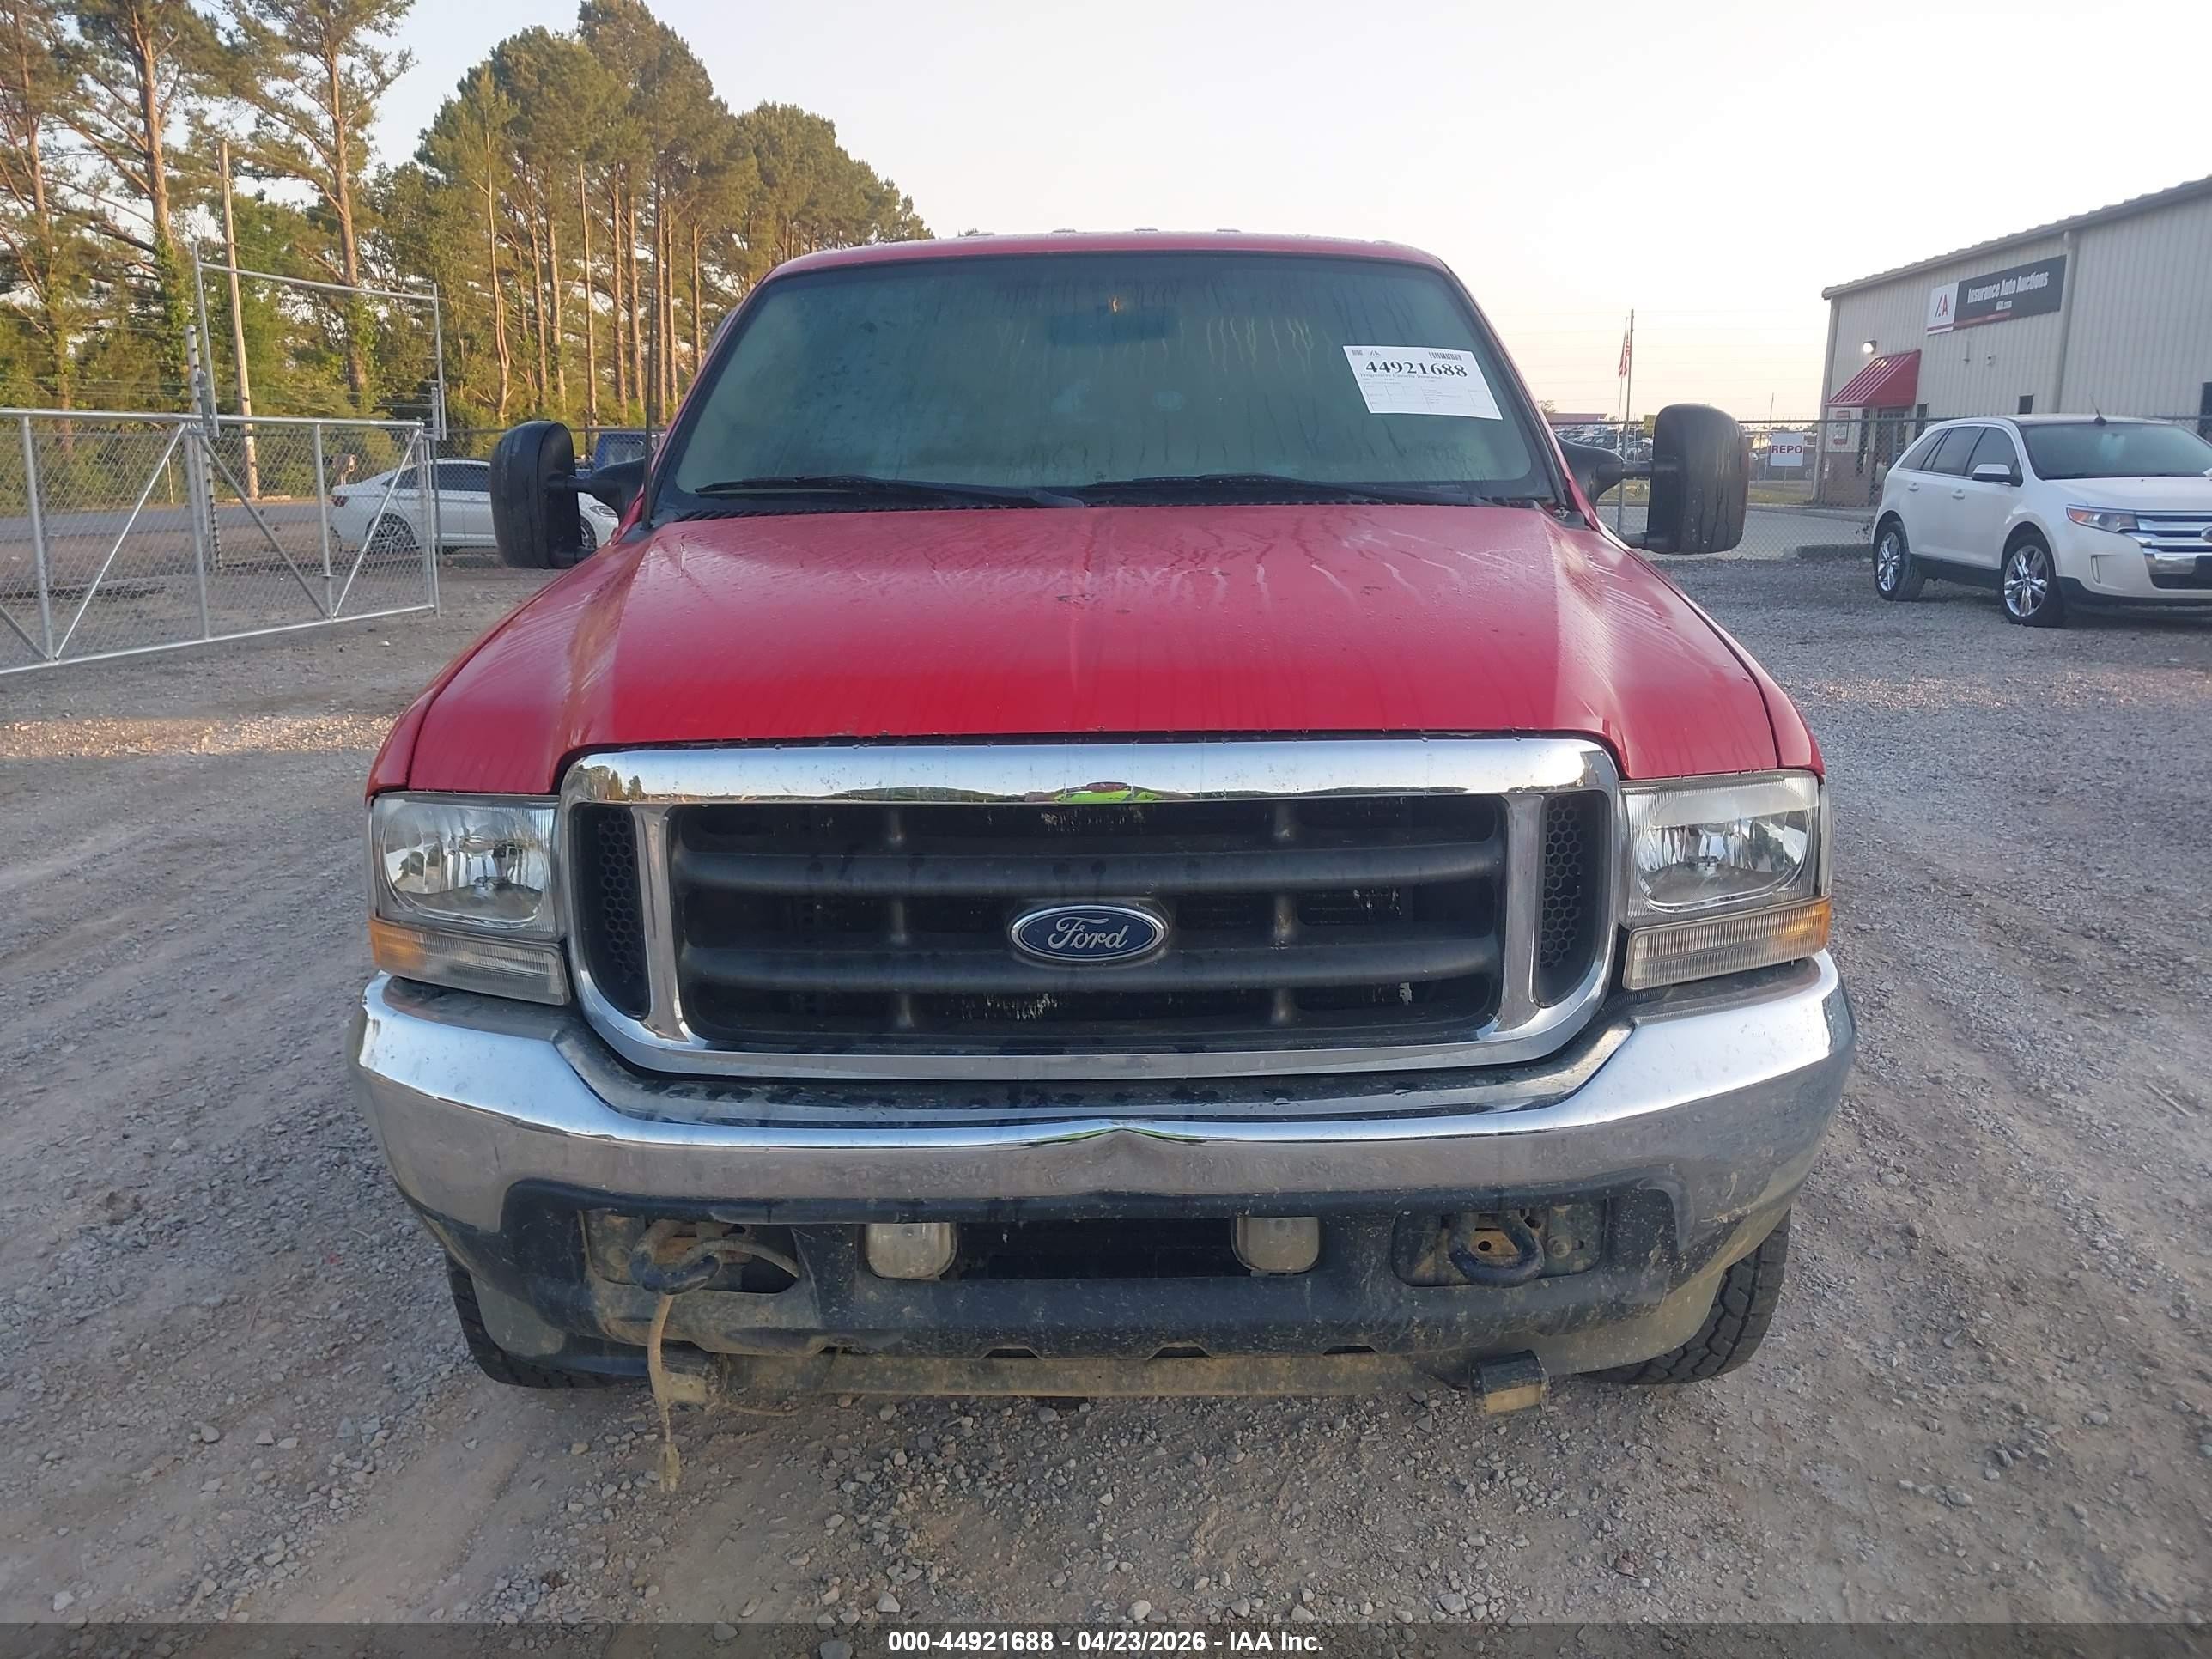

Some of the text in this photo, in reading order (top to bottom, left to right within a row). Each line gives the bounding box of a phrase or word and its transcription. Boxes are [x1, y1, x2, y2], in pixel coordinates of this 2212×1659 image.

[1967, 271, 2049, 303] Insurance Auto Auctions
[1365, 360, 1468, 378] 44921688
[1771, 445, 1803, 454] REPO
[1048, 916, 1129, 949] Ford
